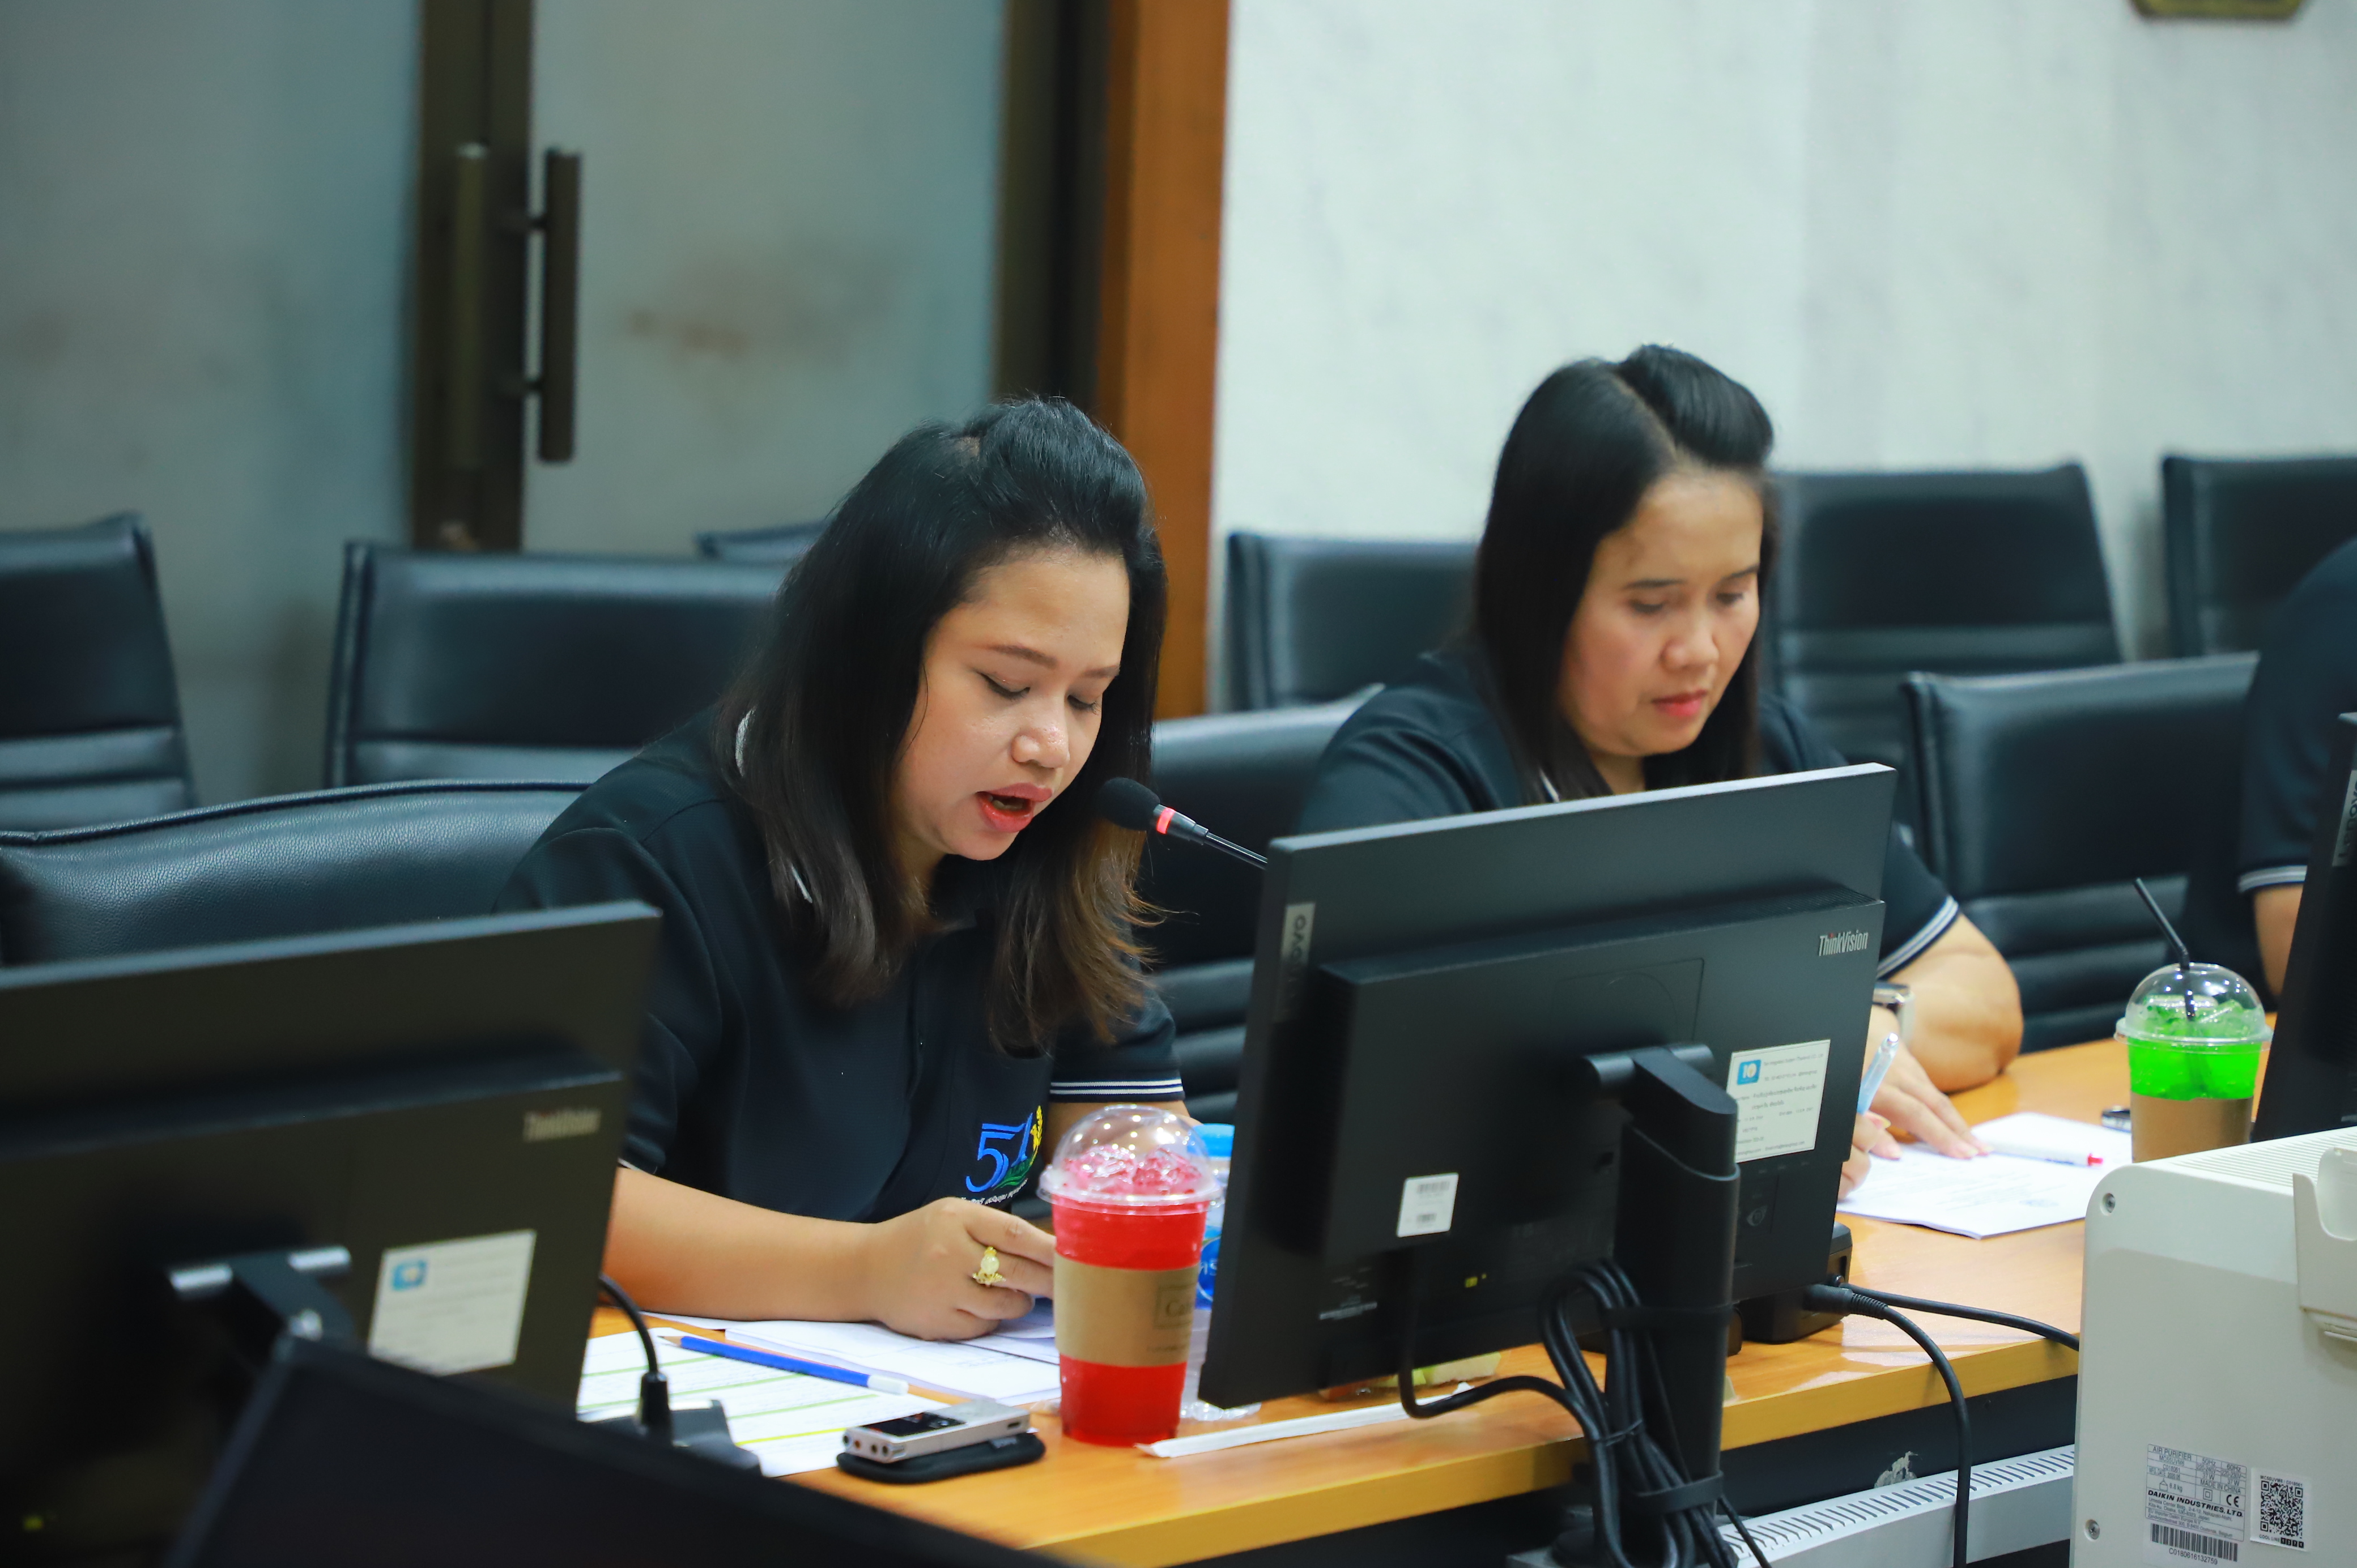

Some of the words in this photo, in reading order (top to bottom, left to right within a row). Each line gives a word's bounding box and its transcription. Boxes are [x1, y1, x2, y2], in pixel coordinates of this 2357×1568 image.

[1818, 930, 1869, 957] ThinkVision
[2164, 1449, 2191, 1460] PURIFIER
[2224, 1485, 2241, 1494] CHINA
[2148, 1490, 2174, 1501] DAIKIN
[2169, 1548, 2218, 1565] C0180616132759
